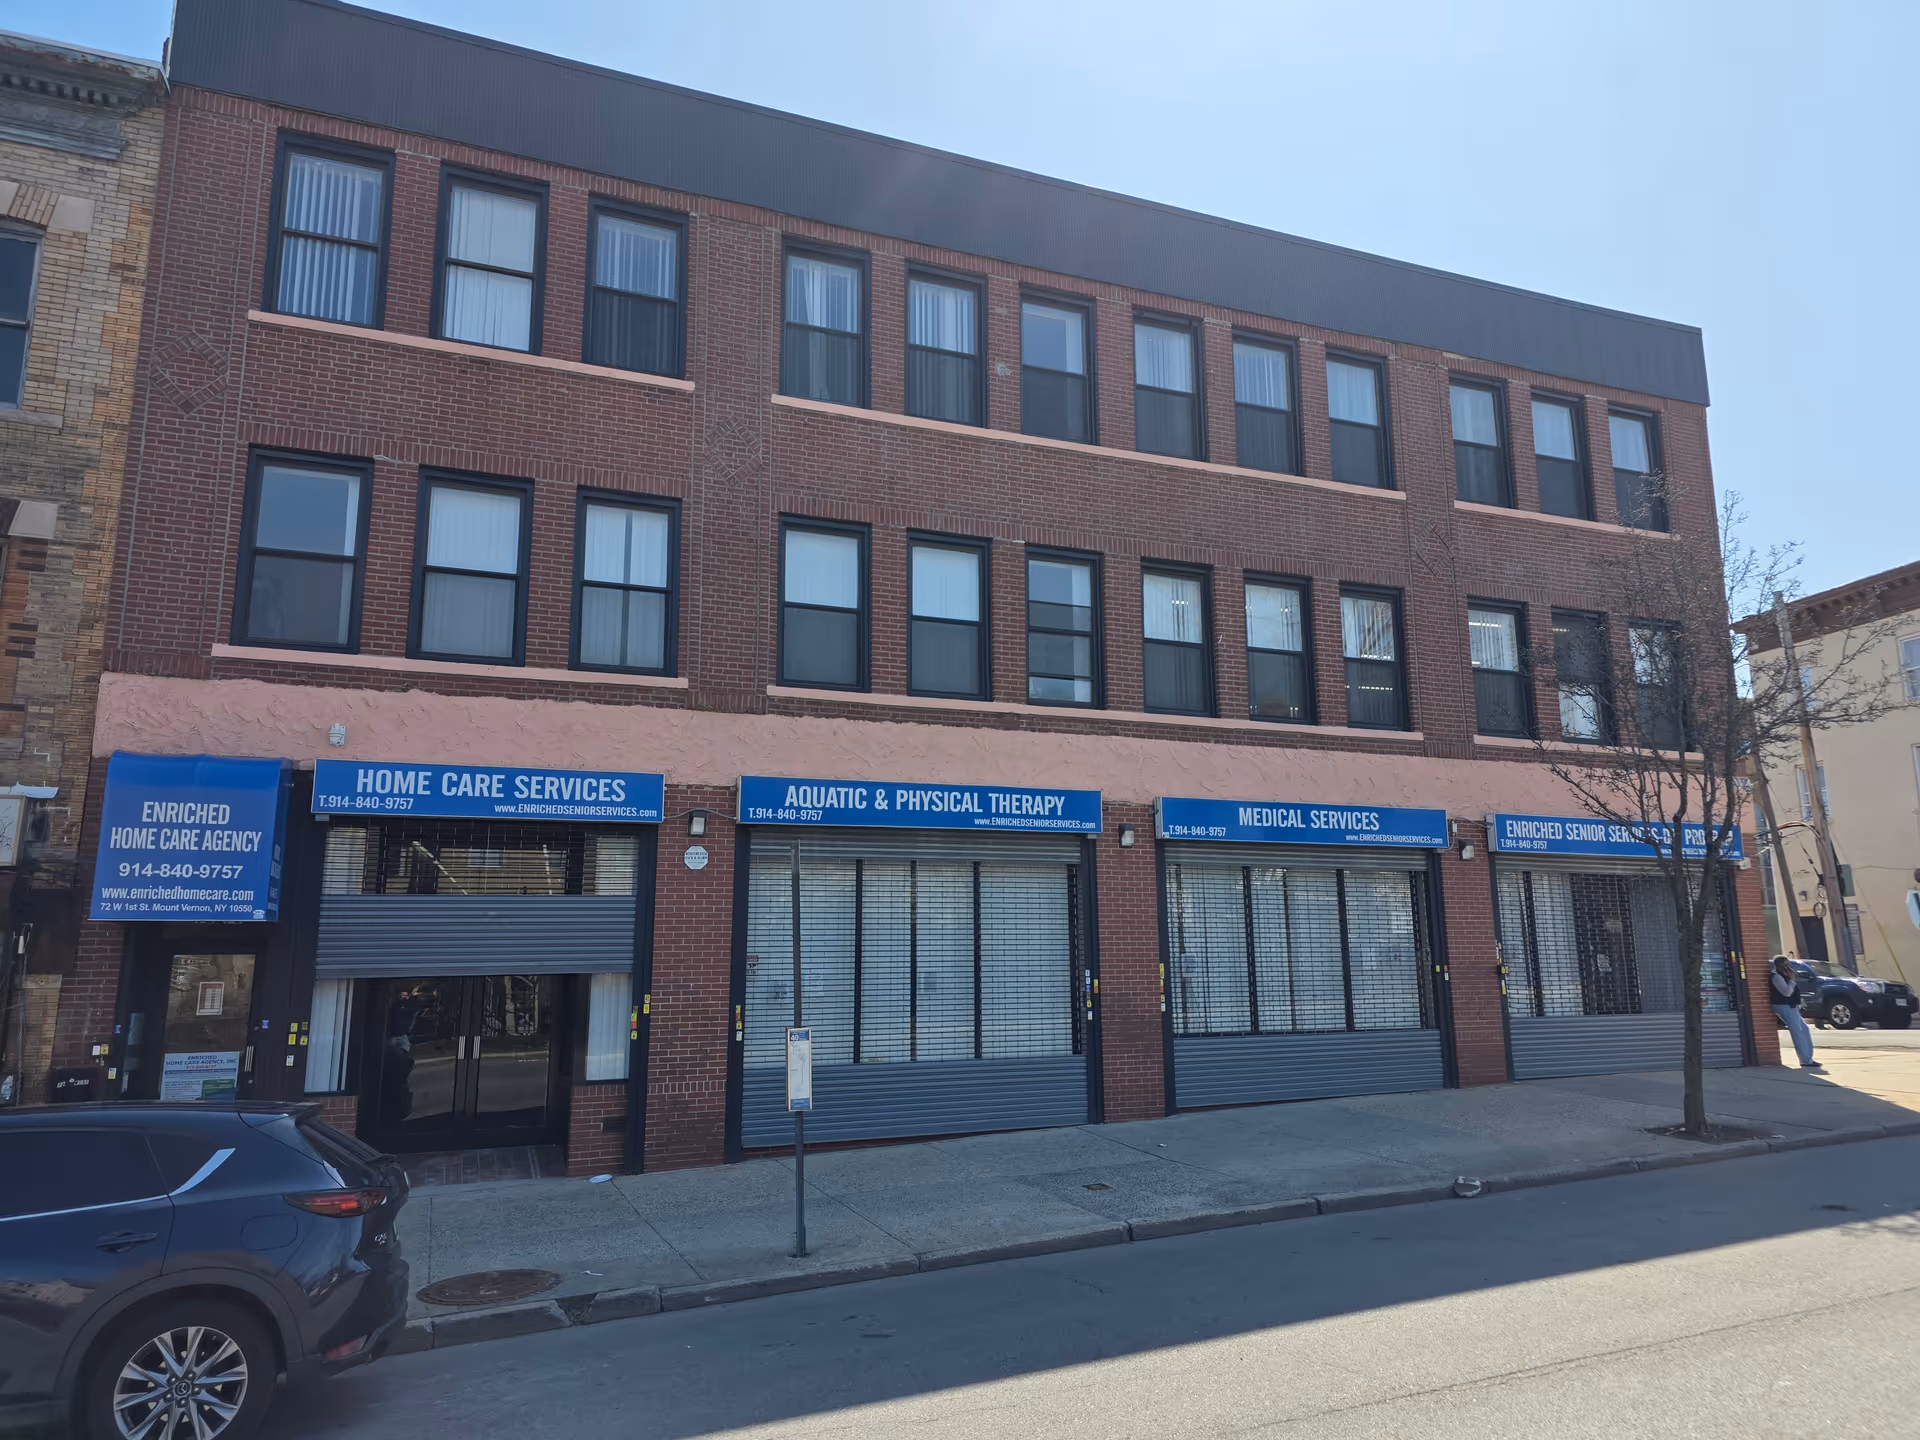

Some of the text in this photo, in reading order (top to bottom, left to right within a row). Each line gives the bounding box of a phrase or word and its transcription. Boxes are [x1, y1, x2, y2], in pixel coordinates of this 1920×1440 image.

[356, 769, 626, 802] HOME CARE SERVICES
[318, 795, 414, 810] T.914-840-9757
[784, 785, 1066, 816] AQUATIC & PHYSICAL THERAPY
[141, 801, 231, 825] ENRICHED
[494, 803, 658, 818] www.ENRICHEDSENIORSERVICES.com
[748, 807, 823, 821] T.914-840-9757
[974, 817, 1096, 829] www.ENRICHEDSENIORSERVICES.com
[1239, 807, 1380, 831] MEDICAL SERVICES
[1168, 825, 1227, 837] T.914-840-9757
[1506, 820, 1563, 840] ENRICHED
[1565, 823, 1606, 842] SENIOR
[110, 827, 263, 852] HOME CARE AGENCY
[119, 862, 243, 879] 914-840-9757
[101, 885, 254, 901] www.enrichedhomecare.com
[100, 903, 253, 913] 72 W 1st St. Mount Vernon, NY 10550
